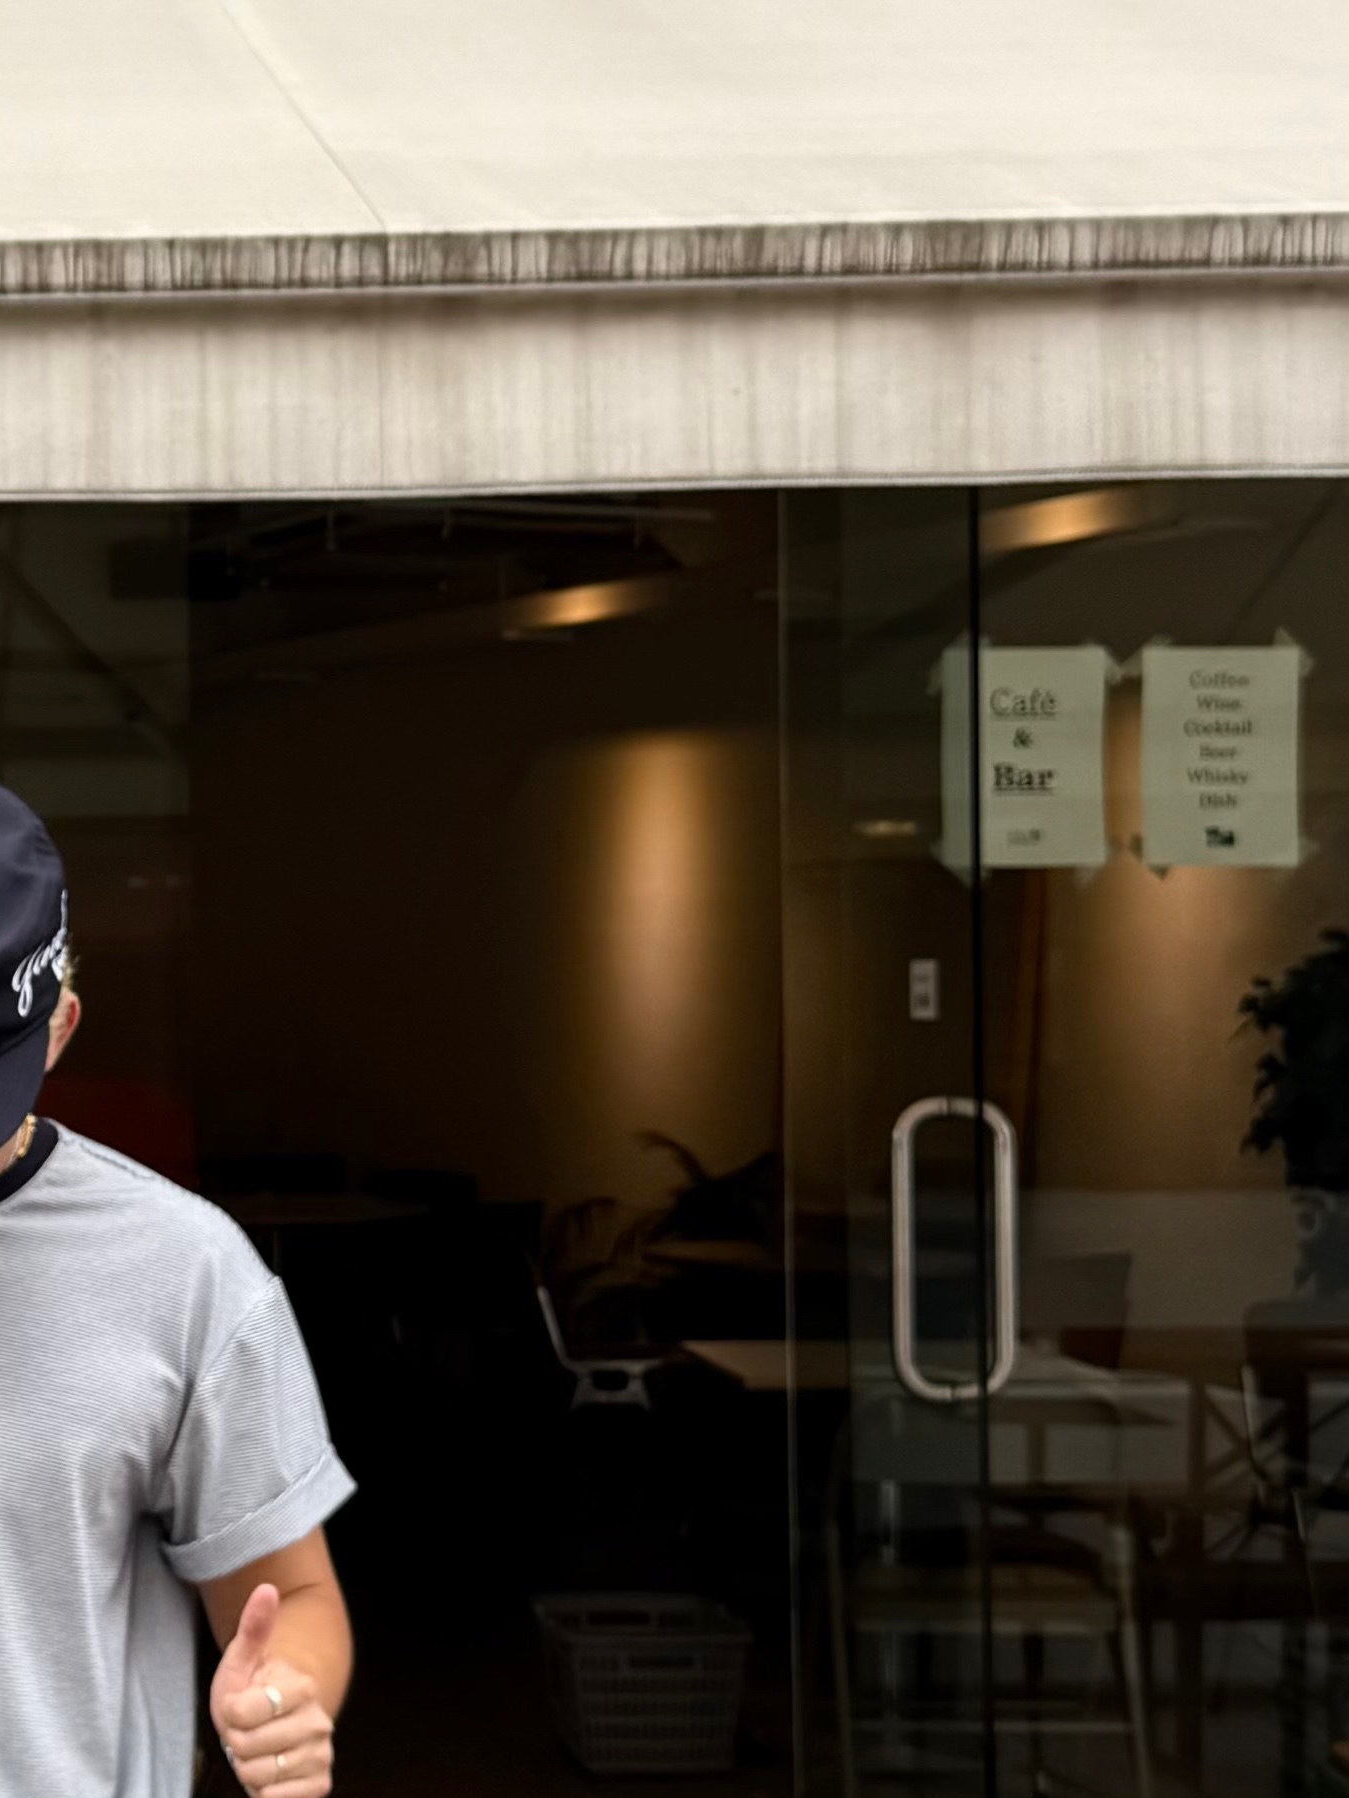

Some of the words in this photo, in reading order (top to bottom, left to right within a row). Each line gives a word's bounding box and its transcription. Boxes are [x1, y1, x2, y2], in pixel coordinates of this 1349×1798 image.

[1012, 727, 1033, 748] &
[1183, 720, 1253, 737] Cocktail
[993, 762, 1053, 787] Bar
